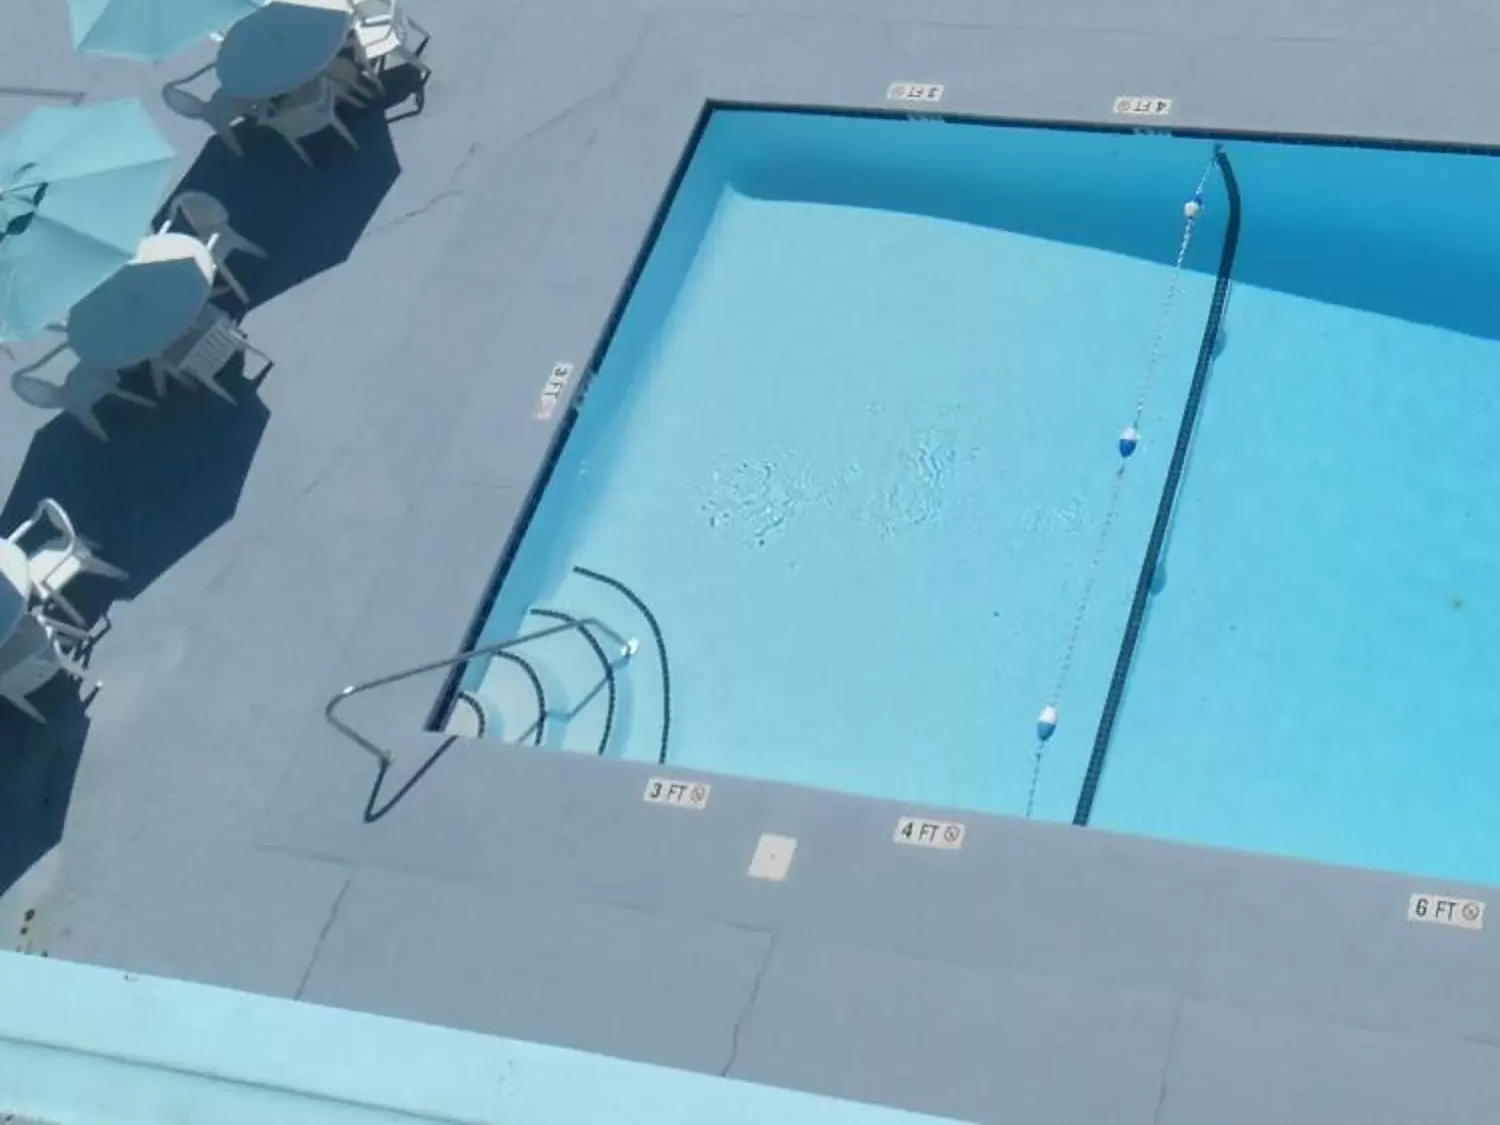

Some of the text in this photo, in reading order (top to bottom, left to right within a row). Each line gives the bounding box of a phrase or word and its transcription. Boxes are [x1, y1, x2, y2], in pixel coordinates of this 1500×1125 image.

[907, 85, 924, 98] FT
[1132, 100, 1167, 113] 4 FT
[543, 381, 563, 401] FT
[651, 782, 688, 803] 3 FT
[901, 822, 940, 843] 4 FT
[1415, 897, 1457, 922] 6 FT
